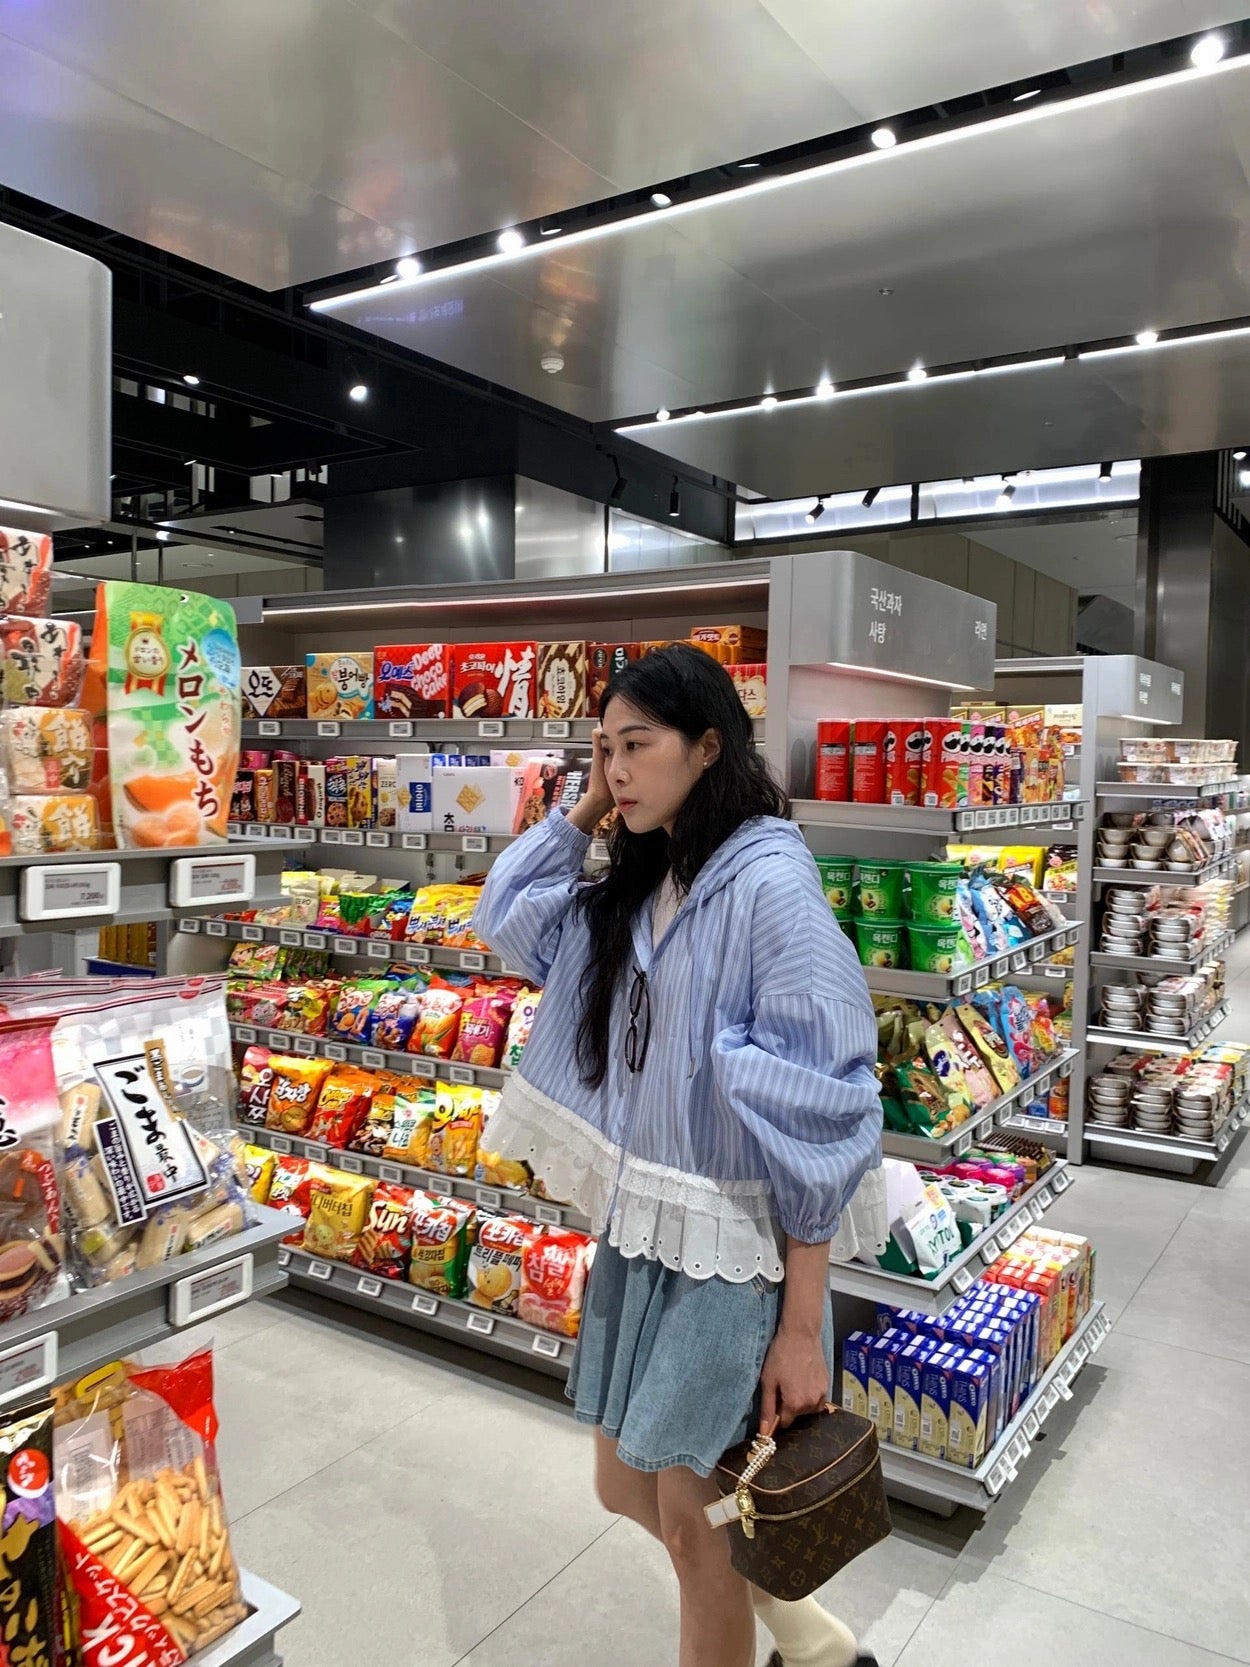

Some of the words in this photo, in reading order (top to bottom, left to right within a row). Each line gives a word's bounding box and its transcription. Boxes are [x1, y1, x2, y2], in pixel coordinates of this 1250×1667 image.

[870, 587, 903, 616] 국산과자
[869, 621, 886, 643] 사탕
[974, 620, 988, 641] 라면
[378, 660, 415, 682] 오예스
[459, 660, 495, 673] 초코파이
[496, 645, 535, 718] 情
[178, 638, 219, 818] メロンもち
[363, 1200, 409, 1235] Sun
[412, 1209, 453, 1242] 포카칩
